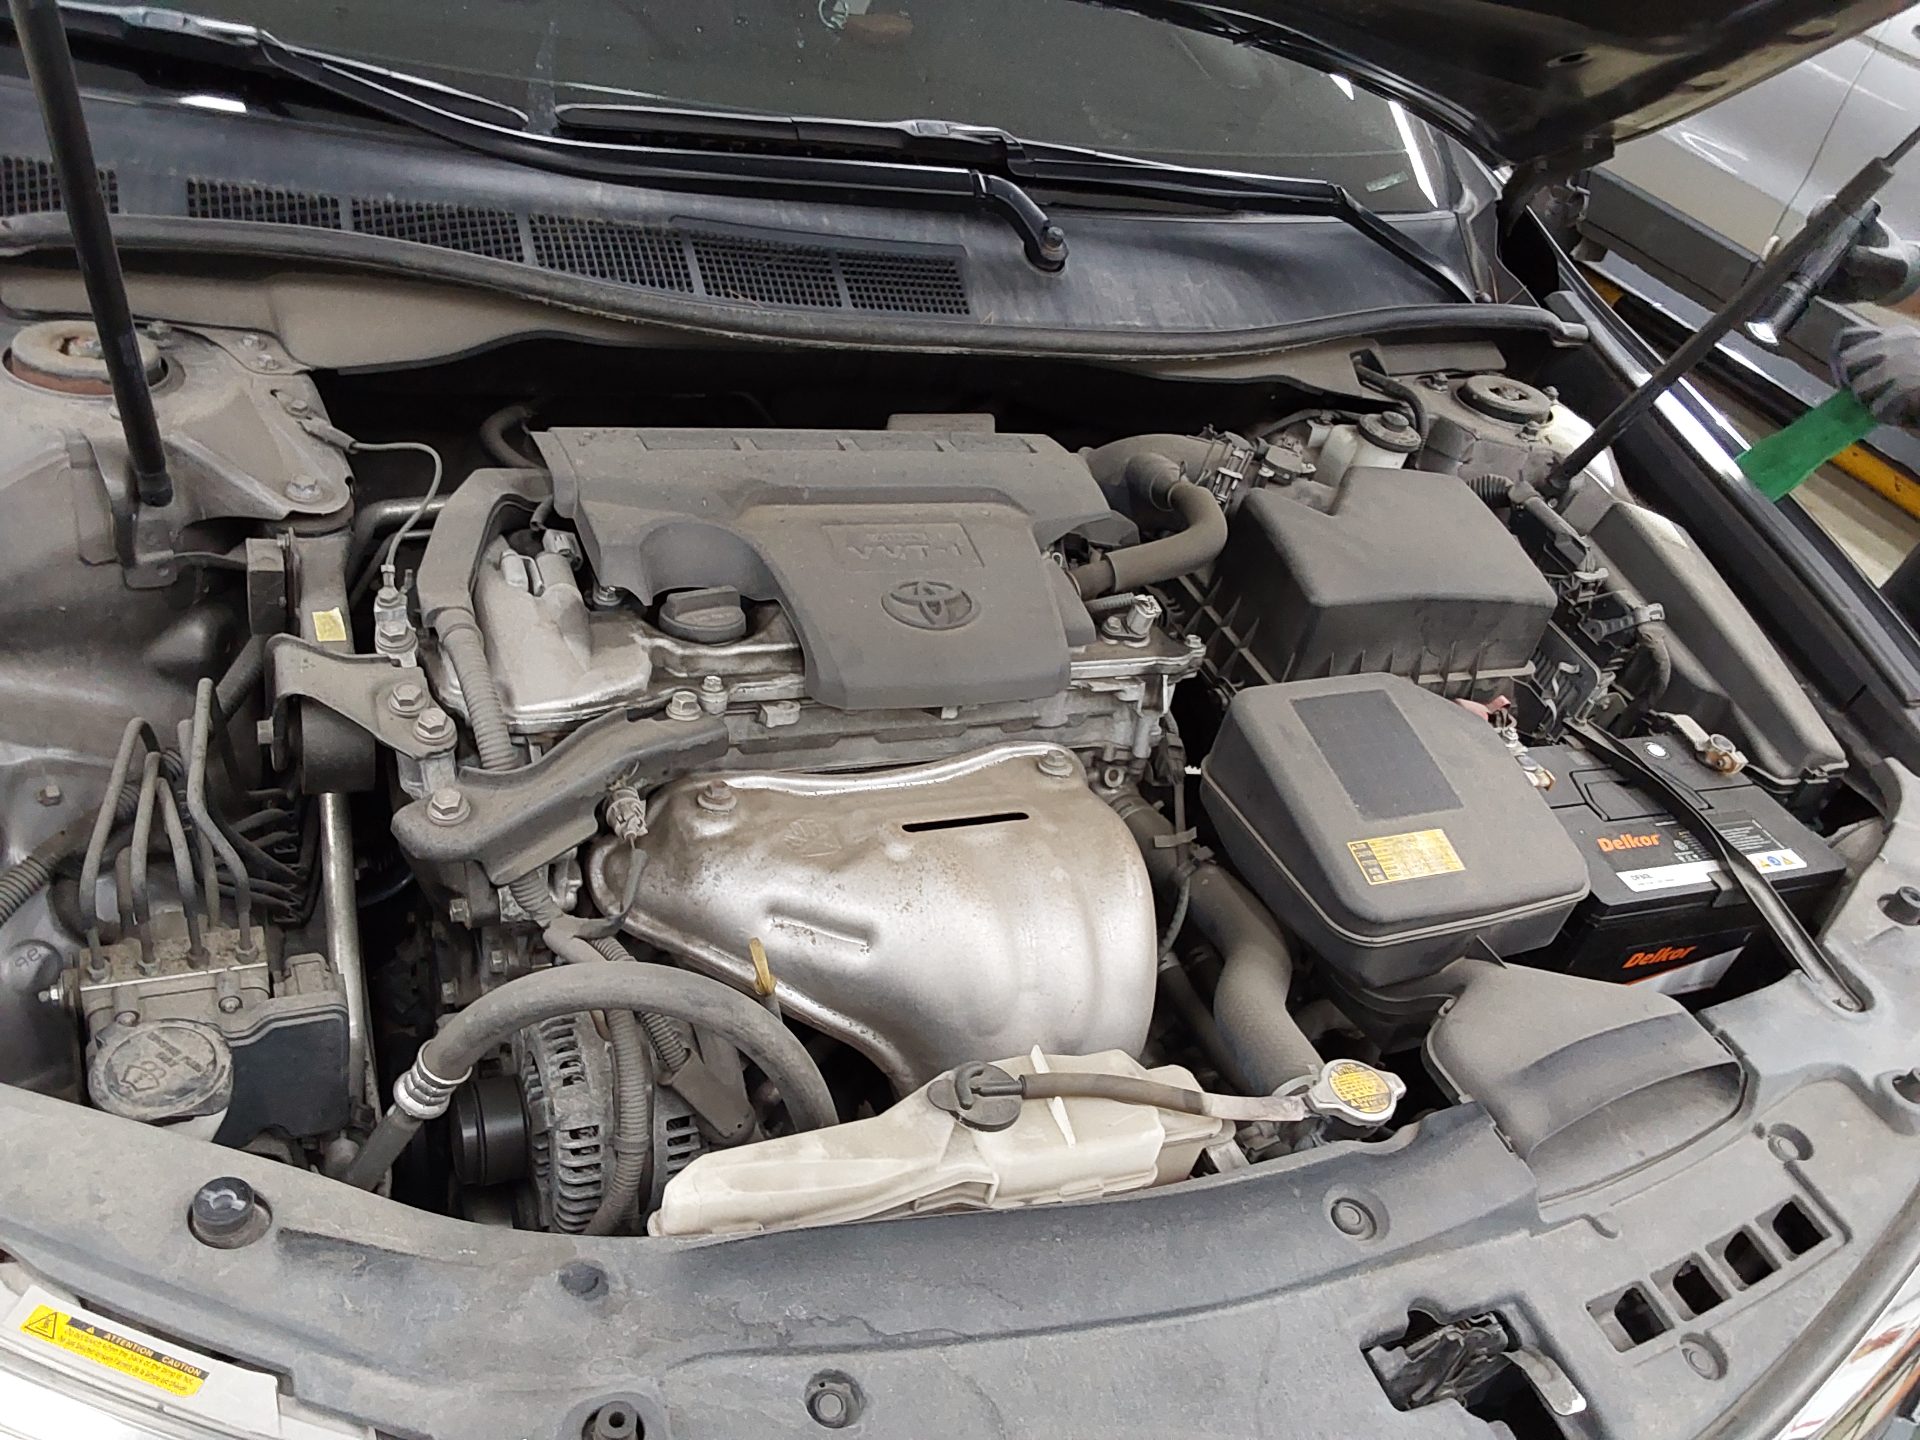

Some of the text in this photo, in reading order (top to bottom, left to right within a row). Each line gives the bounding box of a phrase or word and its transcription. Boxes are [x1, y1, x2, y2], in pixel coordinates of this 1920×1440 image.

[1597, 833, 1660, 852] Delkor
[1622, 945, 1697, 969] Delkor
[103, 1332, 154, 1358] ATTENTION
[161, 1355, 202, 1377] CAUTION
